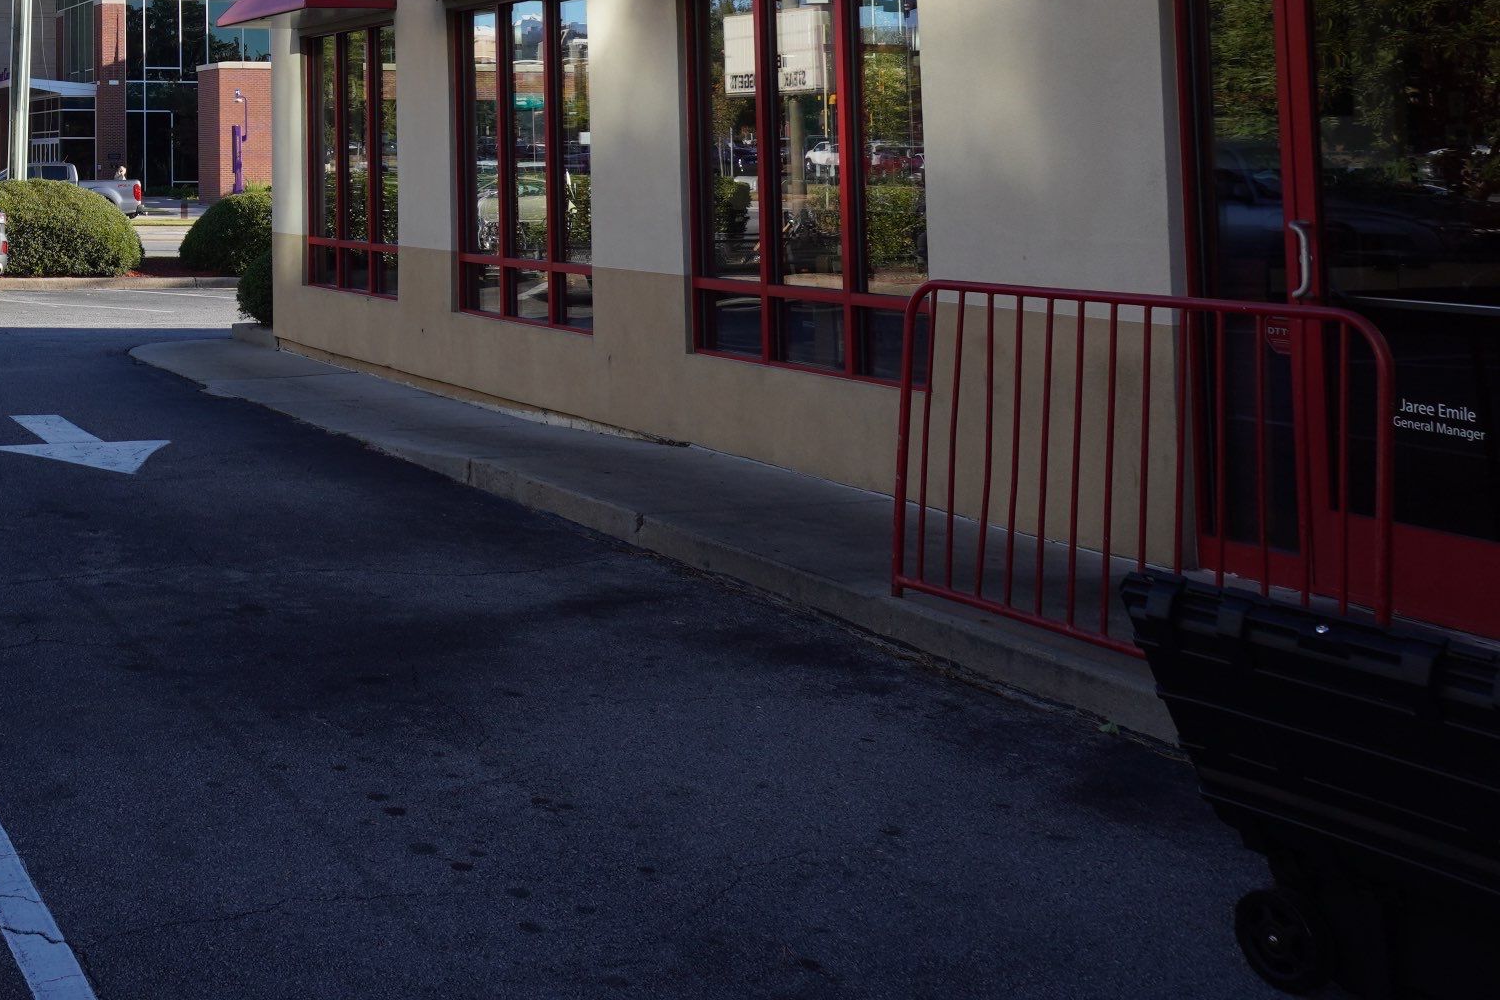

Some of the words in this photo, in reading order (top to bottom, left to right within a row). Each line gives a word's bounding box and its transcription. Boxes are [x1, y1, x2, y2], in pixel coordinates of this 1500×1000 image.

[1400, 398, 1435, 416] Jaree
[1438, 403, 1476, 423] Emile
[1393, 415, 1434, 433] General
[1437, 423, 1486, 442] Manager
